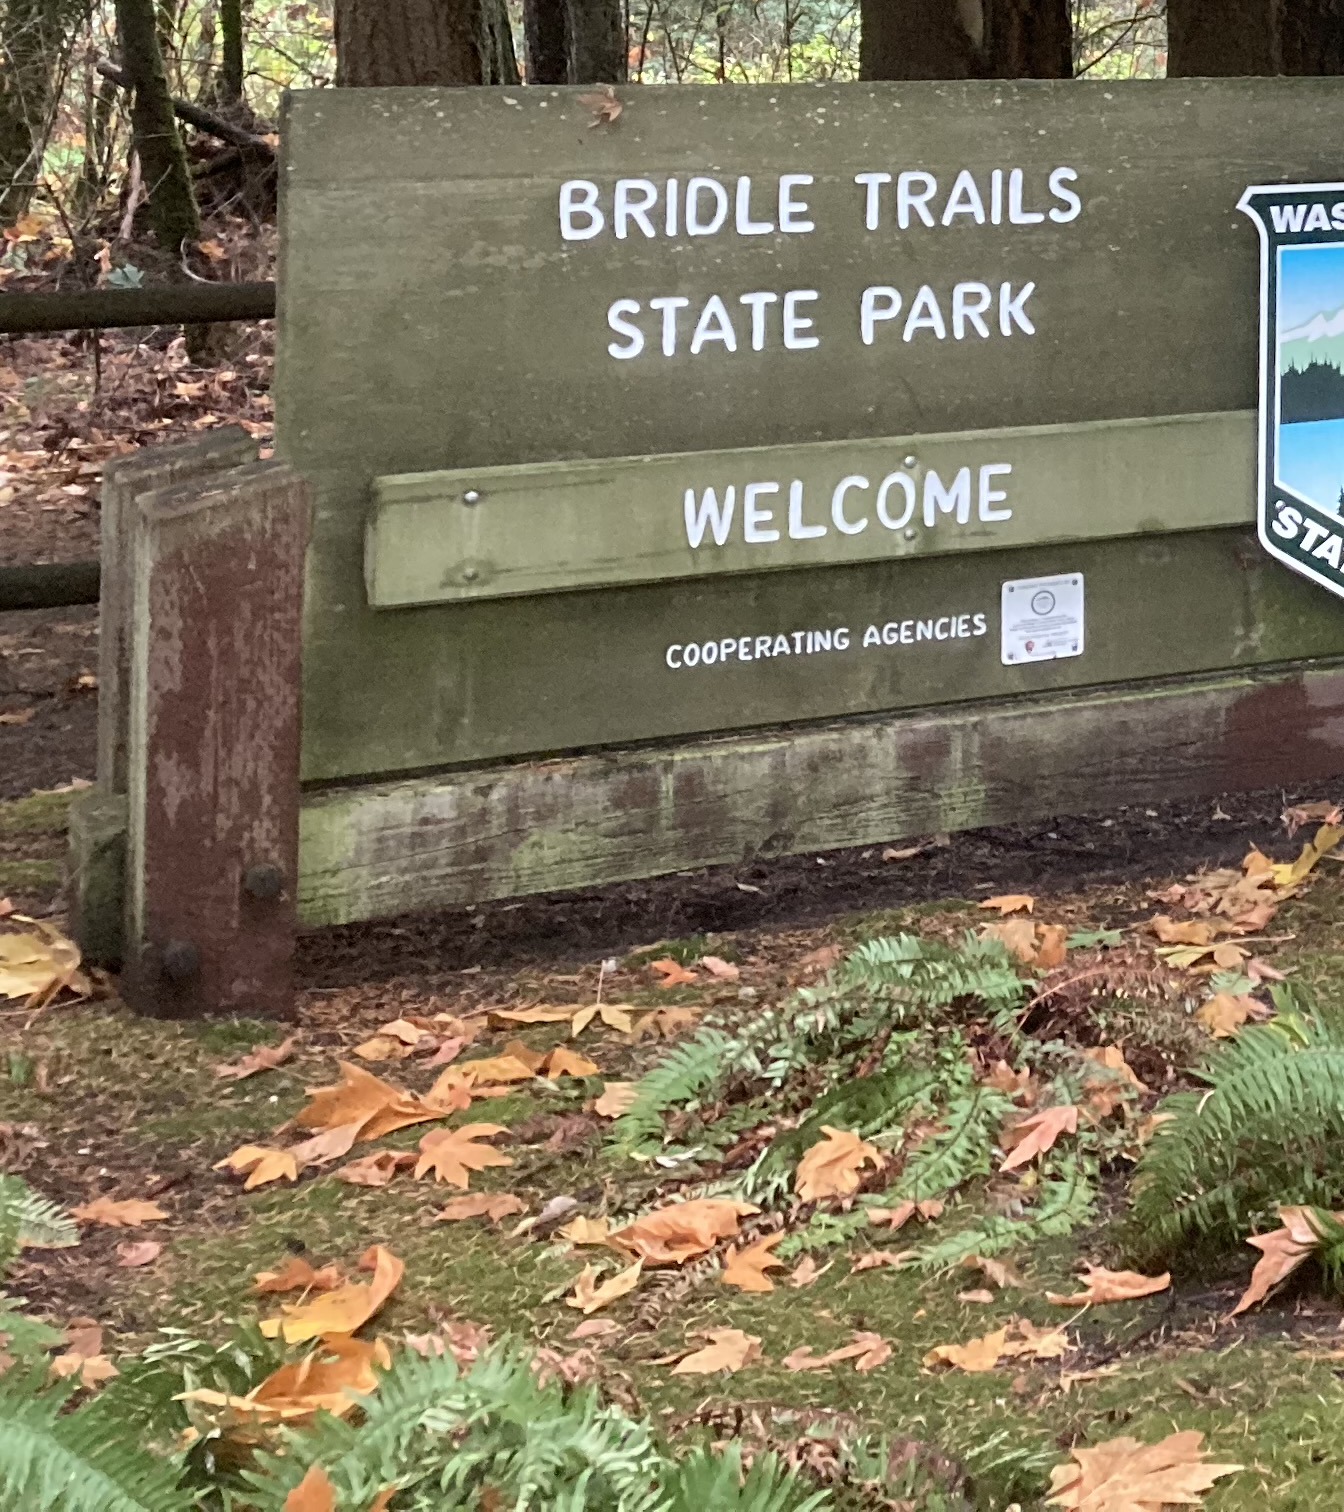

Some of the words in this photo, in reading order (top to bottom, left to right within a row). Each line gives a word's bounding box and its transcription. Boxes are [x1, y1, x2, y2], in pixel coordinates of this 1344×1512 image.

[559, 174, 815, 241] BRIDLE
[855, 167, 1082, 231] TRAILS
[607, 290, 820, 360] STATE
[860, 281, 1036, 345] PARK
[684, 463, 1013, 548] WELCOME
[666, 627, 850, 668] COOPERATING
[863, 613, 987, 648] AGENCIES
